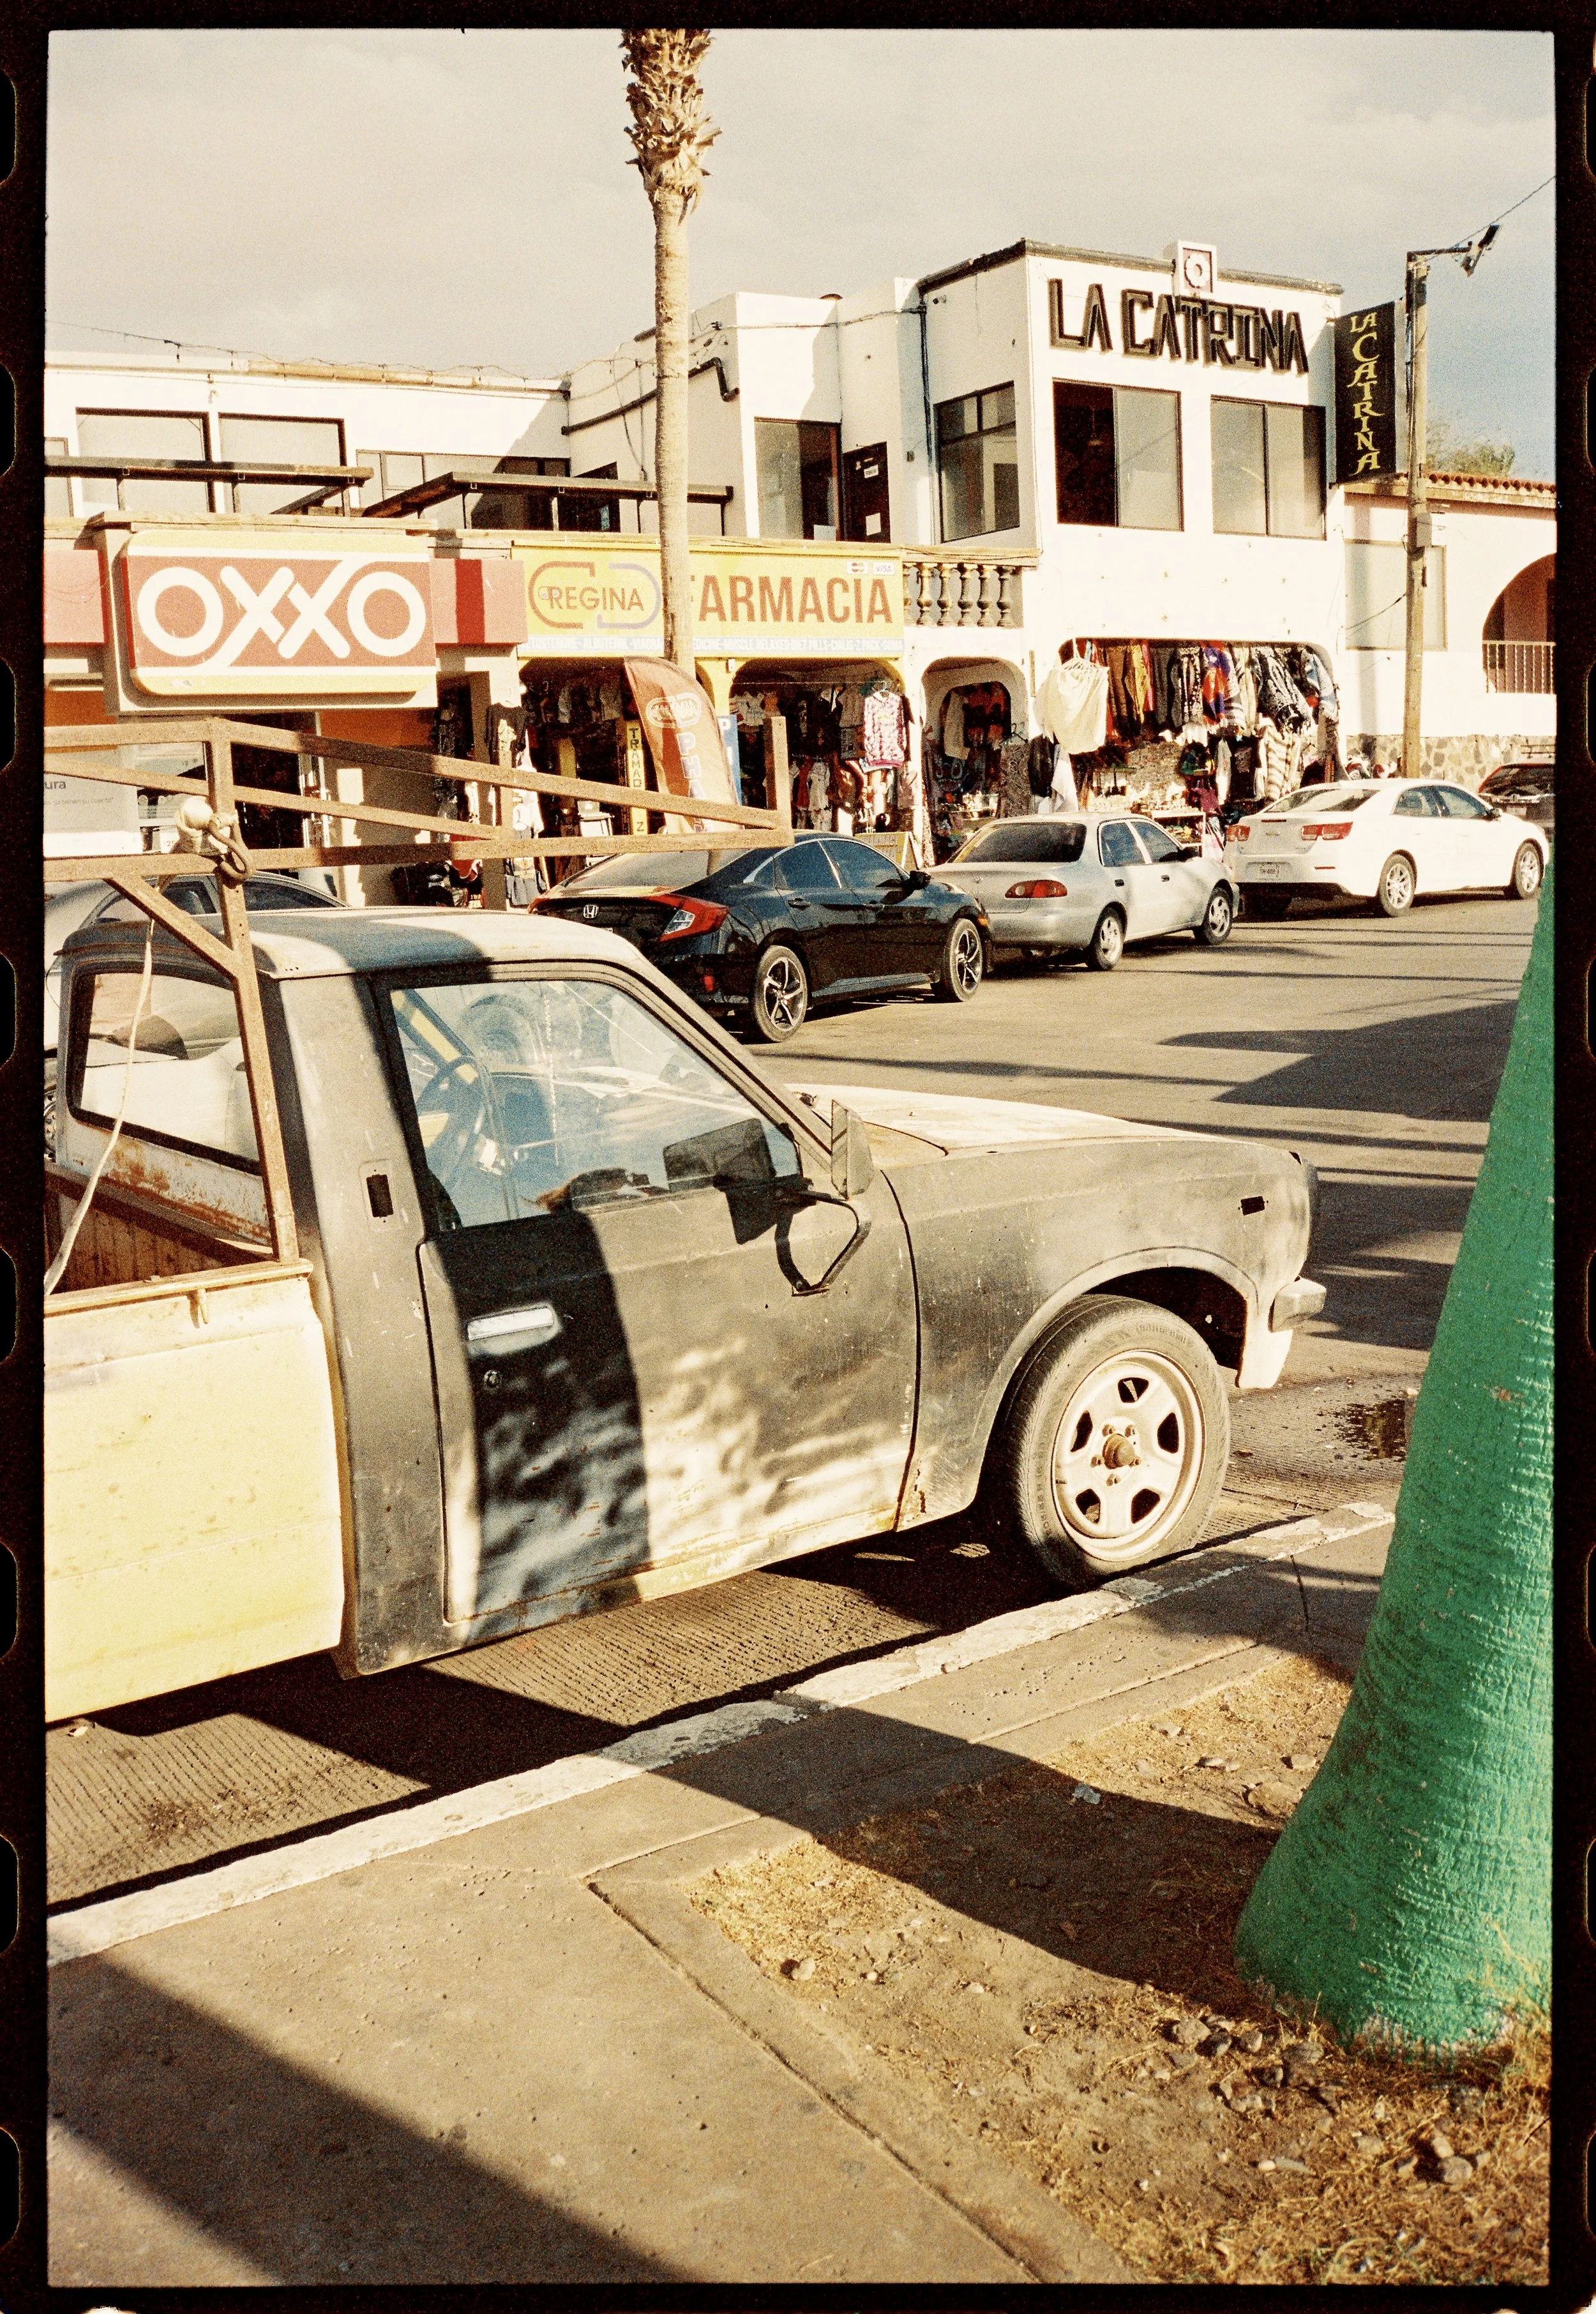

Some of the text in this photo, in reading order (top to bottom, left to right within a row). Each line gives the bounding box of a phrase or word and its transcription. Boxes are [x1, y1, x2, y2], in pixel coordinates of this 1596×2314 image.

[1048, 278, 1310, 377] LA CATRINA
[1346, 312, 1385, 477] LA CATRINA
[137, 566, 426, 659] OXXO
[544, 575, 892, 624] REGINA ARMACIA
[629, 728, 643, 788] TRAMAD
